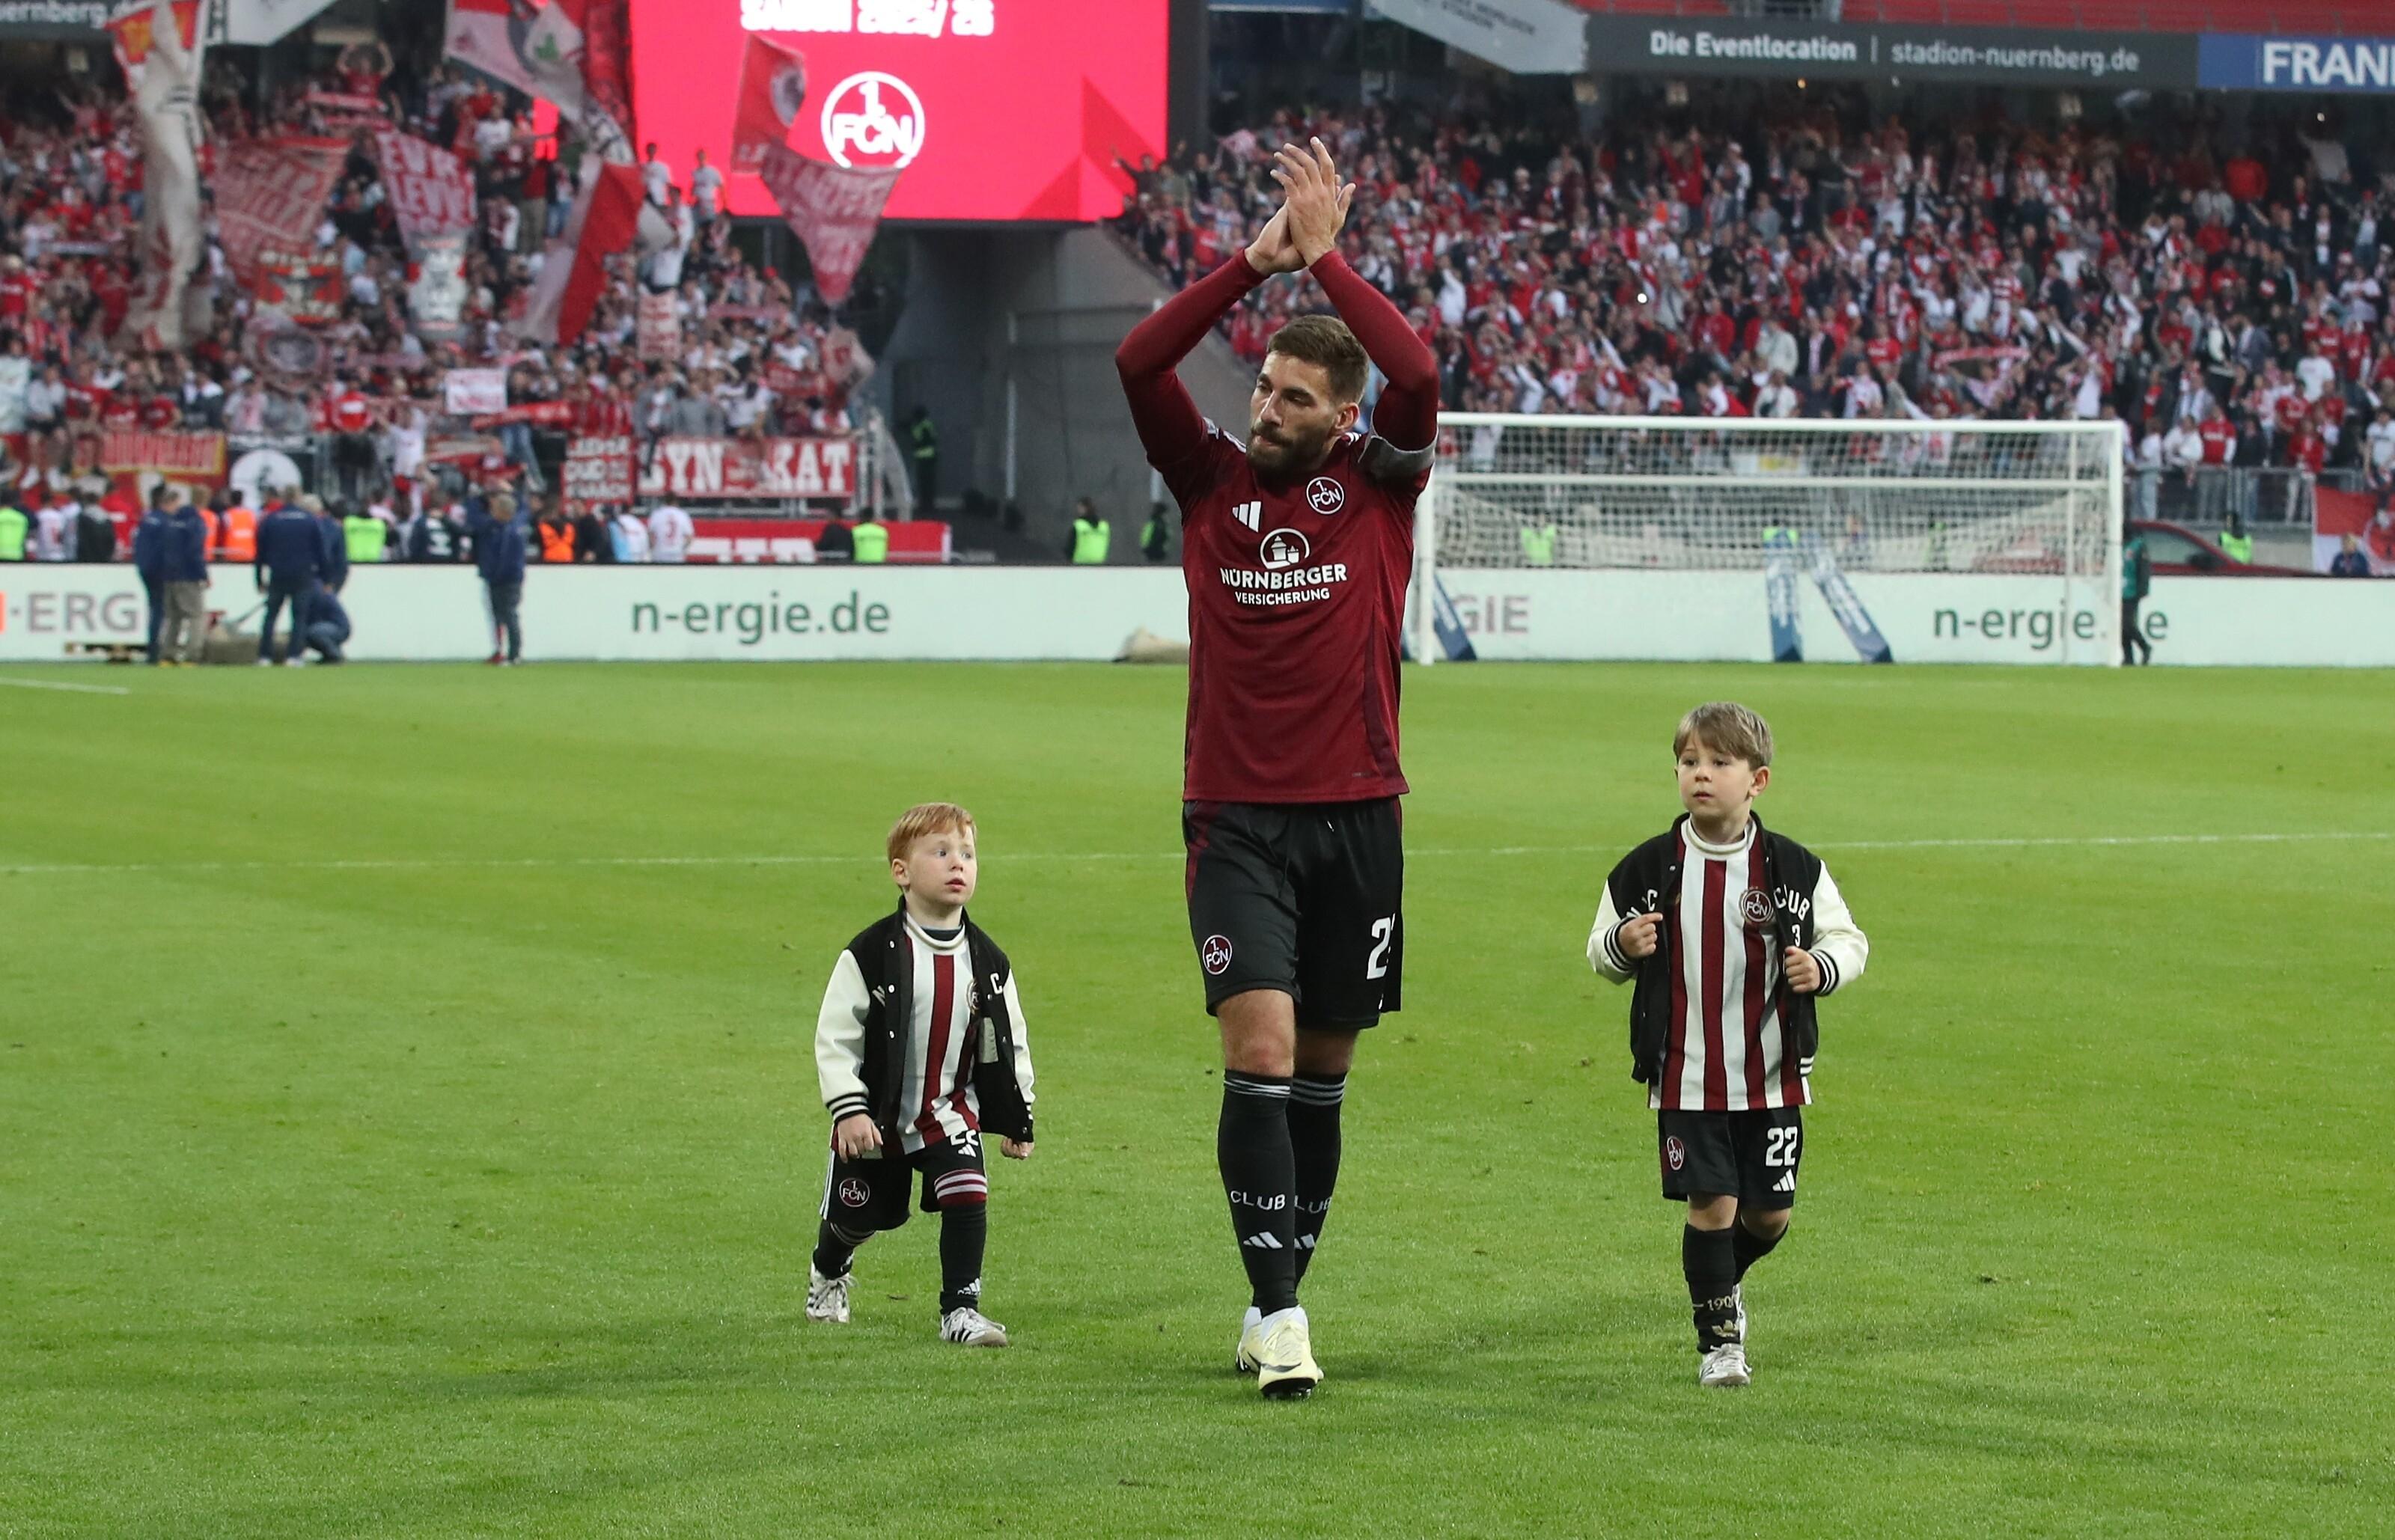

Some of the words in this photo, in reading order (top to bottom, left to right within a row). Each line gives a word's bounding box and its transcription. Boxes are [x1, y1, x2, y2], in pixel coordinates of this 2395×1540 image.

[1650, 31, 1689, 55] Die
[1694, 31, 1857, 60] Eventlocation
[1891, 40, 2139, 76] stadion-nuernberg.de
[2263, 42, 2395, 85] FRAN
[832, 114, 915, 154] FCN
[1311, 489, 1341, 508] FCN
[1219, 563, 1347, 590] NÜRNBERGER
[1235, 588, 1330, 605] VERSICHERUNG
[632, 590, 890, 645] n-ergie.de
[1933, 598, 2168, 650] n-ergie.e
[1745, 900, 1768, 917] FCN
[1205, 948, 1229, 968] FCN
[1765, 1126, 1798, 1167] 22
[842, 1188, 866, 1201] FCN
[1230, 1191, 1286, 1211] CLUB
